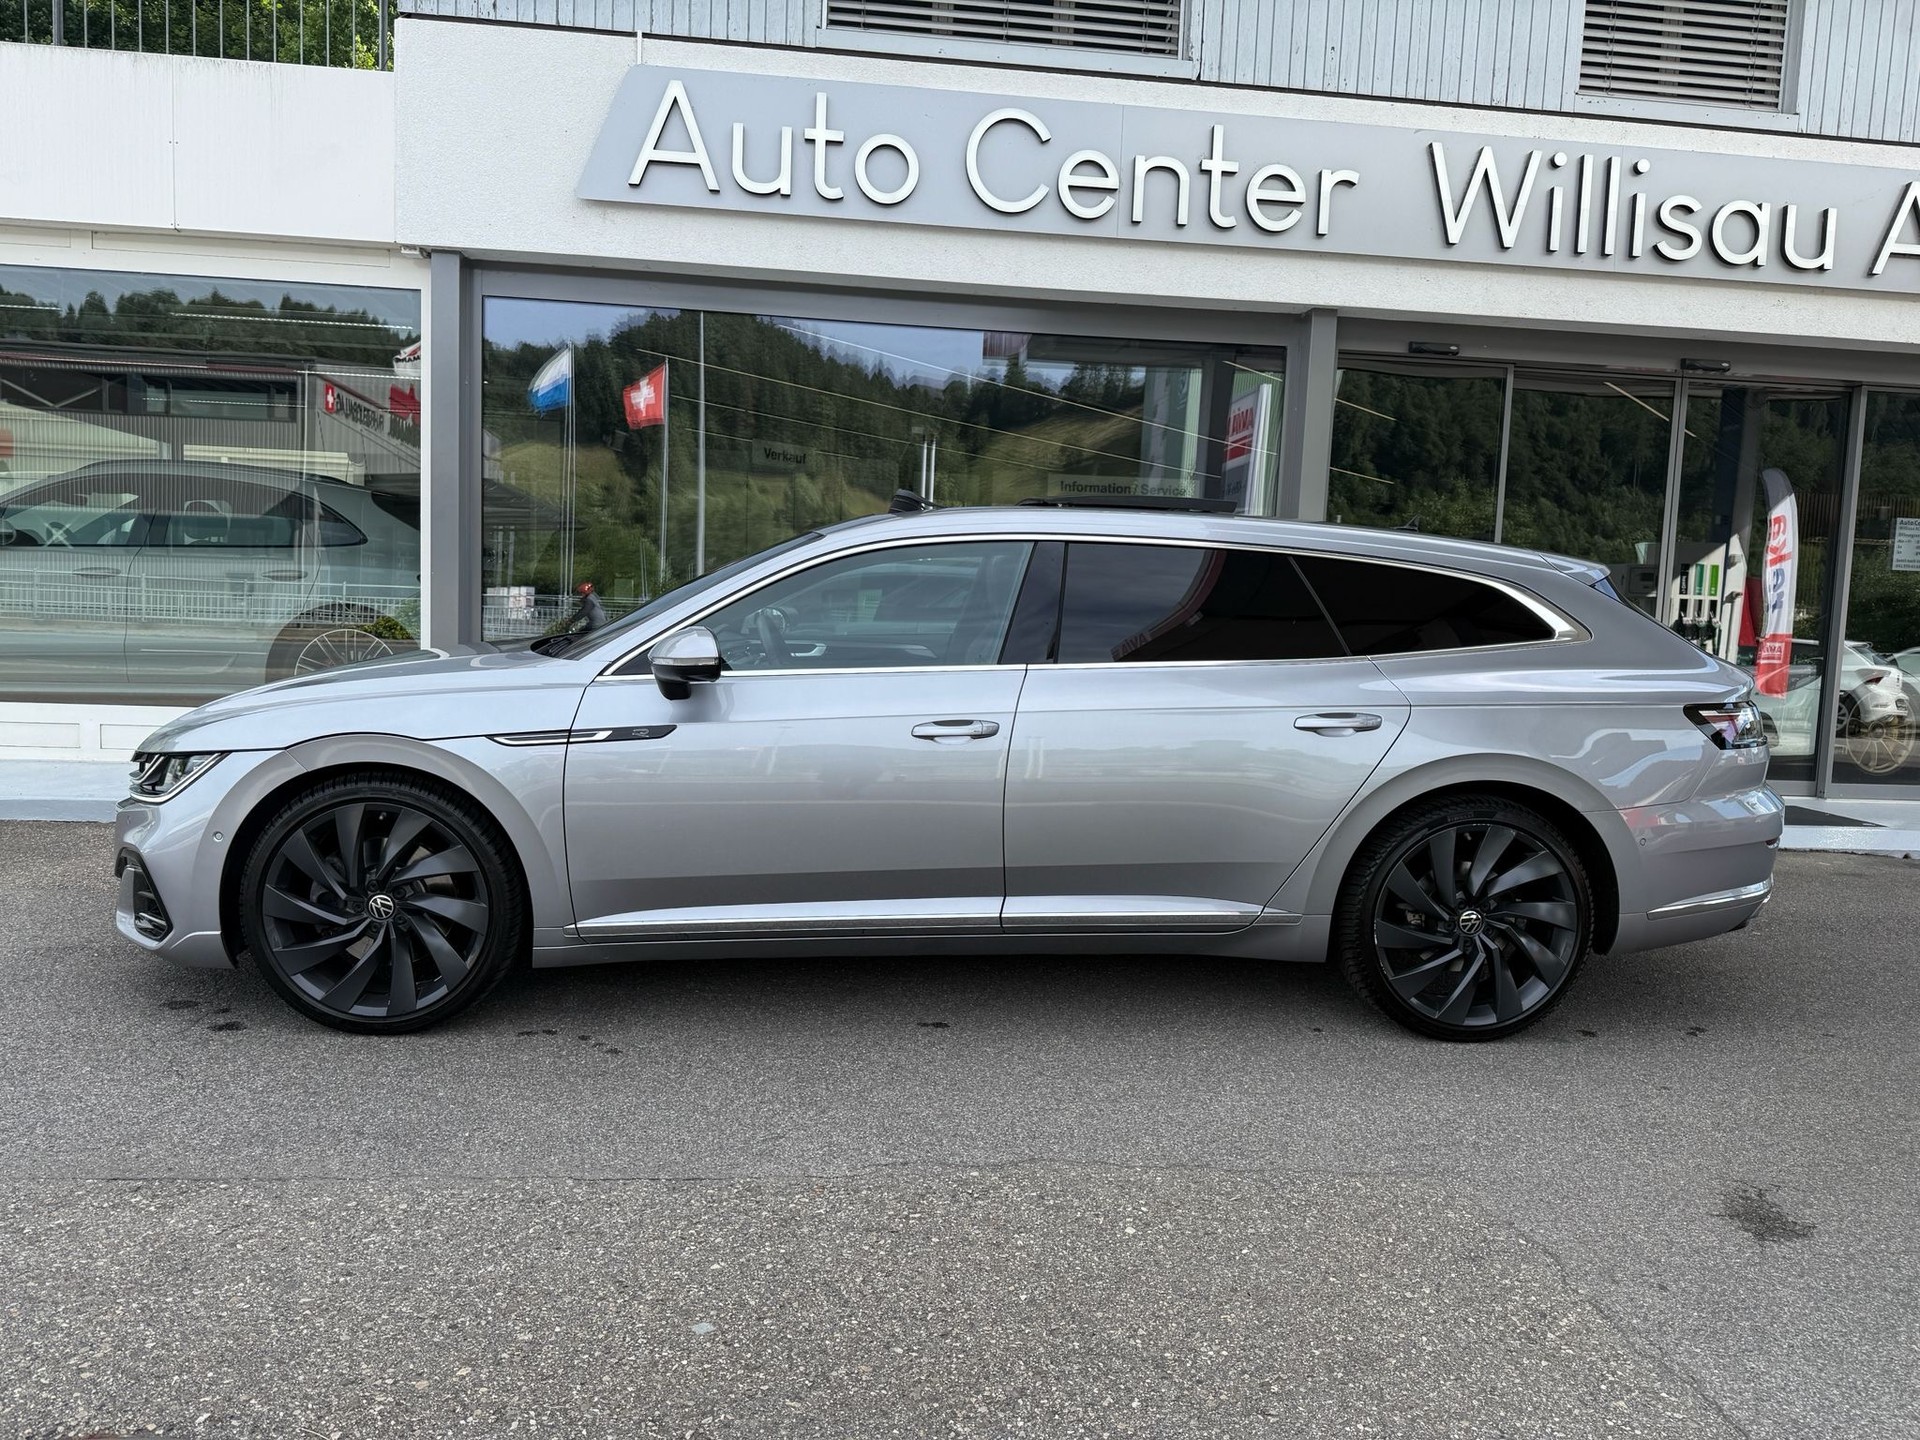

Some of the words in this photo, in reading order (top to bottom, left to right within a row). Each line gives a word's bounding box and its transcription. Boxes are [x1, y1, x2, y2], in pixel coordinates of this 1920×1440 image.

[628, 80, 920, 205] Auto
[966, 108, 1360, 236] Center
[1428, 141, 1837, 271] Willisau
[763, 447, 806, 464] Verkauf
[1060, 480, 1131, 494] Information
[1141, 484, 1187, 496] Service
